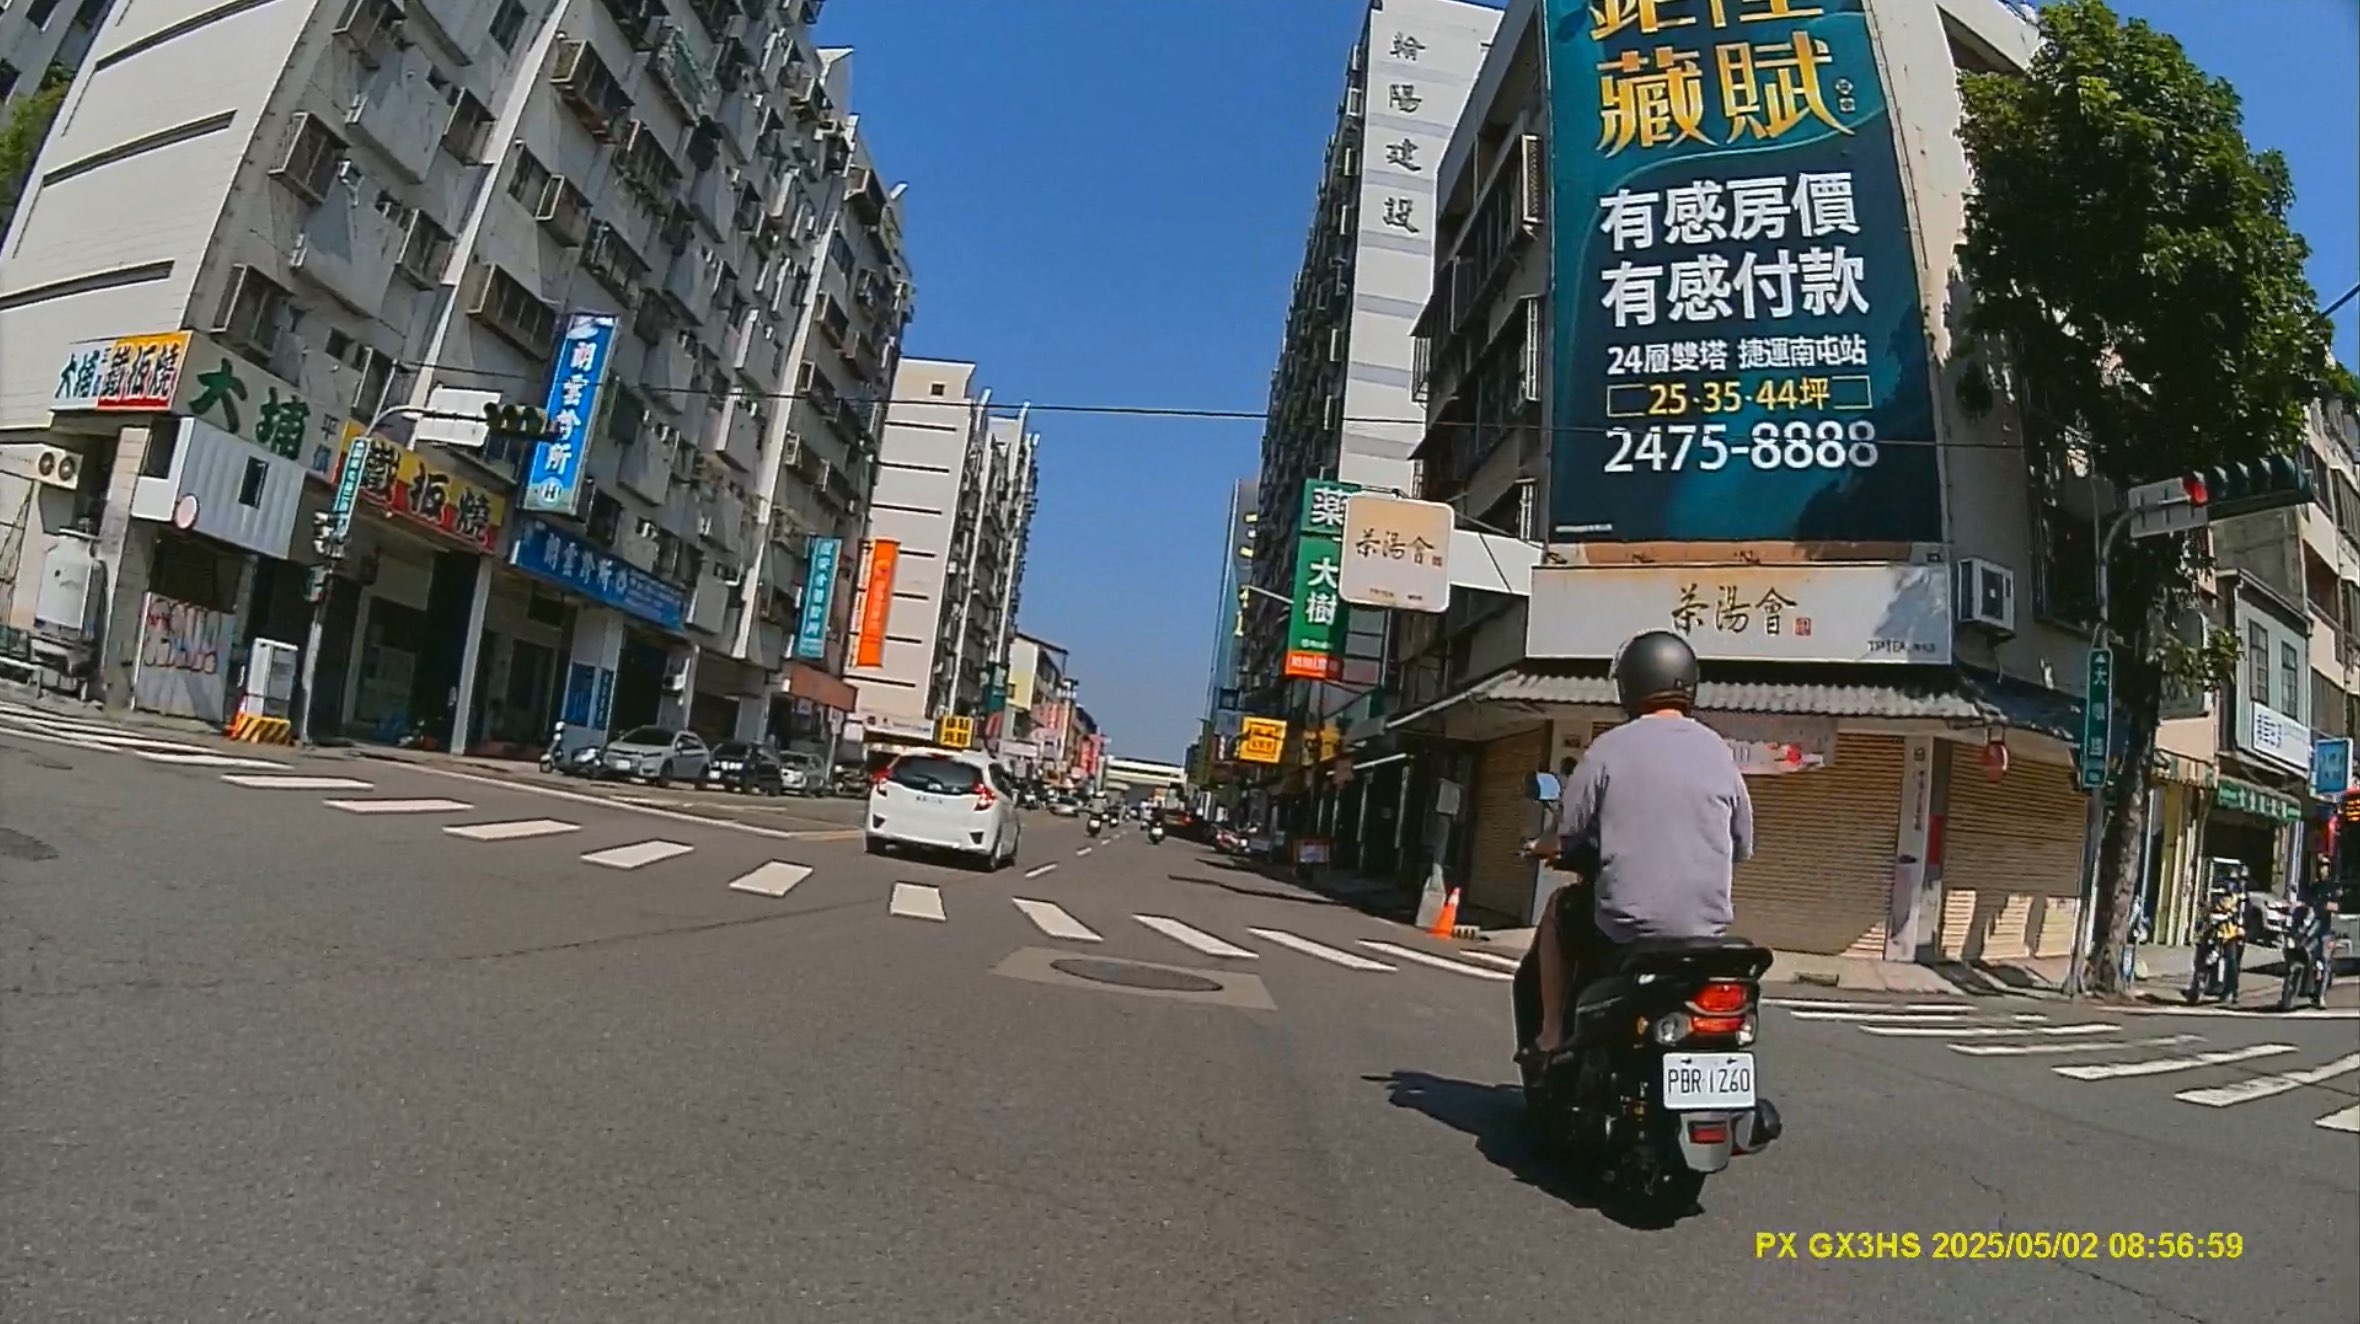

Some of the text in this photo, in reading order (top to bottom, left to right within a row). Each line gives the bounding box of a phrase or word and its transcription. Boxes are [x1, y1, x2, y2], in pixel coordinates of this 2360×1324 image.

[1596, 30, 1856, 159] 藏賦
[1599, 171, 1861, 252] 有感房價
[1600, 245, 1870, 328] 有感付款
[1606, 333, 1868, 375] 24層雙塔 捷運南屯站
[1603, 419, 1879, 473] 2475-8888
[1355, 527, 1436, 566] 茶湯會
[1305, 557, 1339, 626] 大樹
[1672, 583, 1797, 636] 茶湯會
